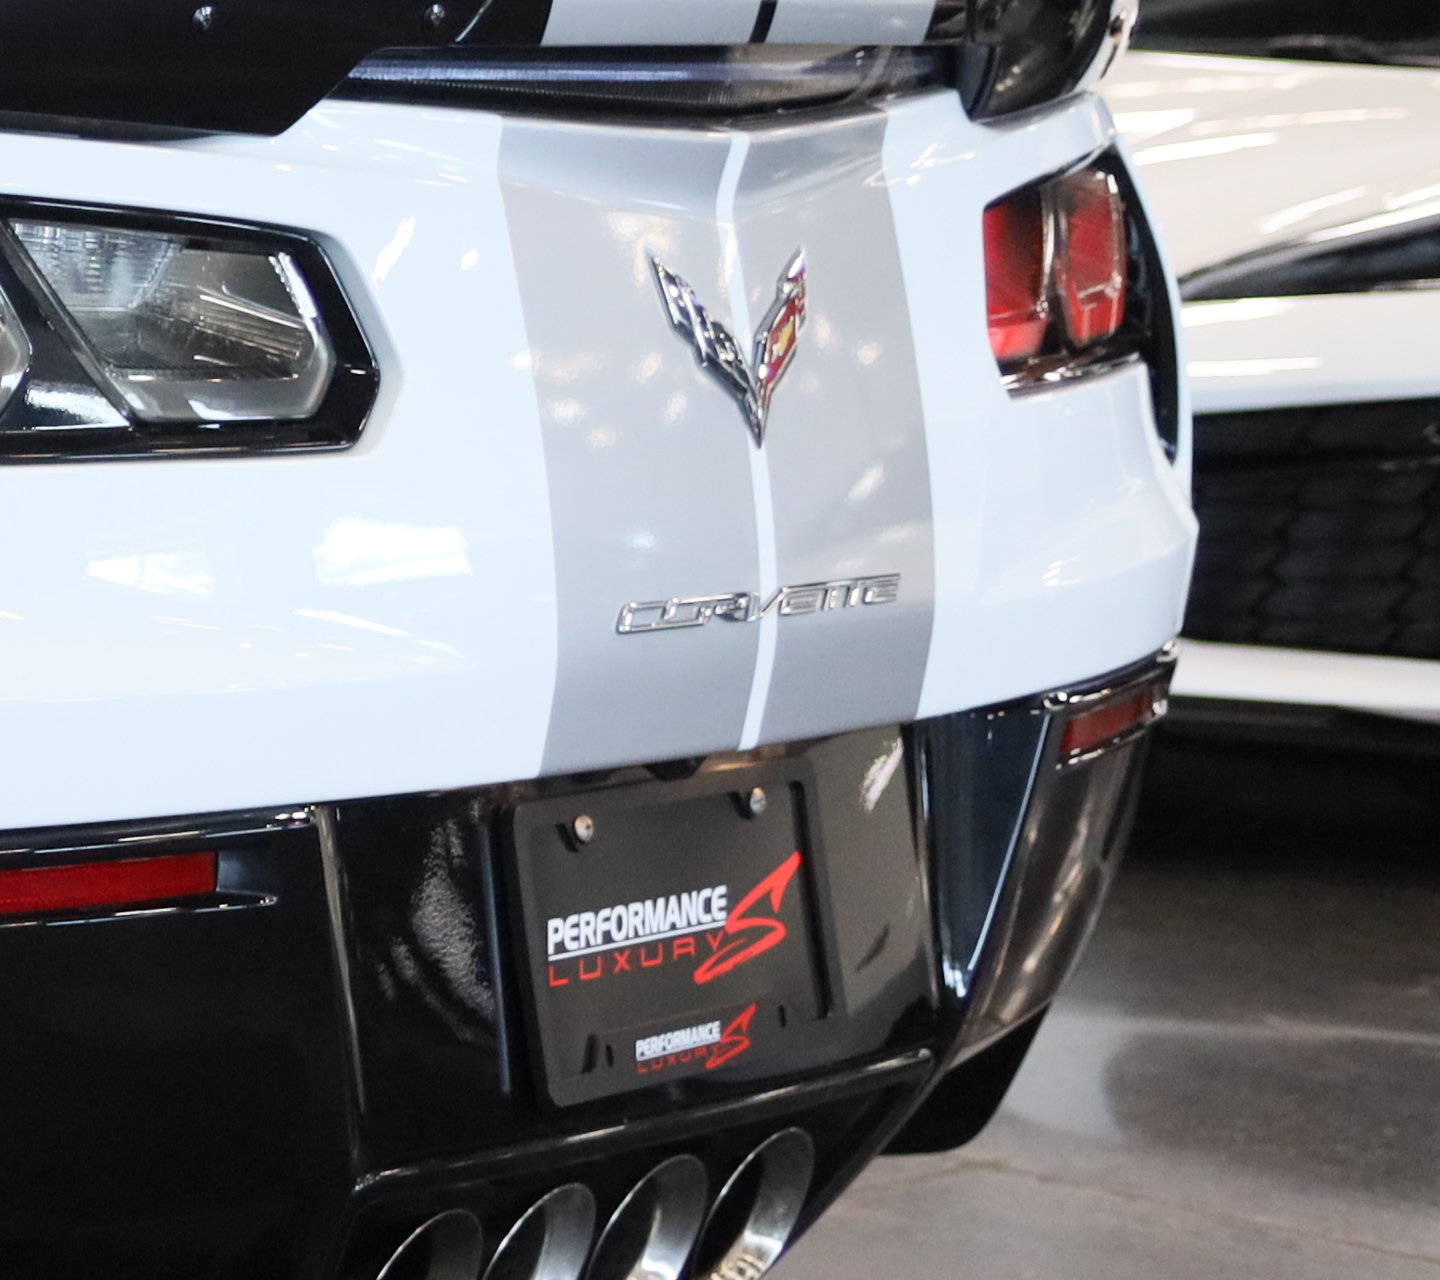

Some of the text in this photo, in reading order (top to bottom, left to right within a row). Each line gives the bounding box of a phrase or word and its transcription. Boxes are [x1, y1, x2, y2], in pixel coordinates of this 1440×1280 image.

[616, 573, 900, 634] CORVETTE
[548, 885, 727, 954] PERFORMANCE
[636, 1020, 721, 1057] PERFORMANCE
